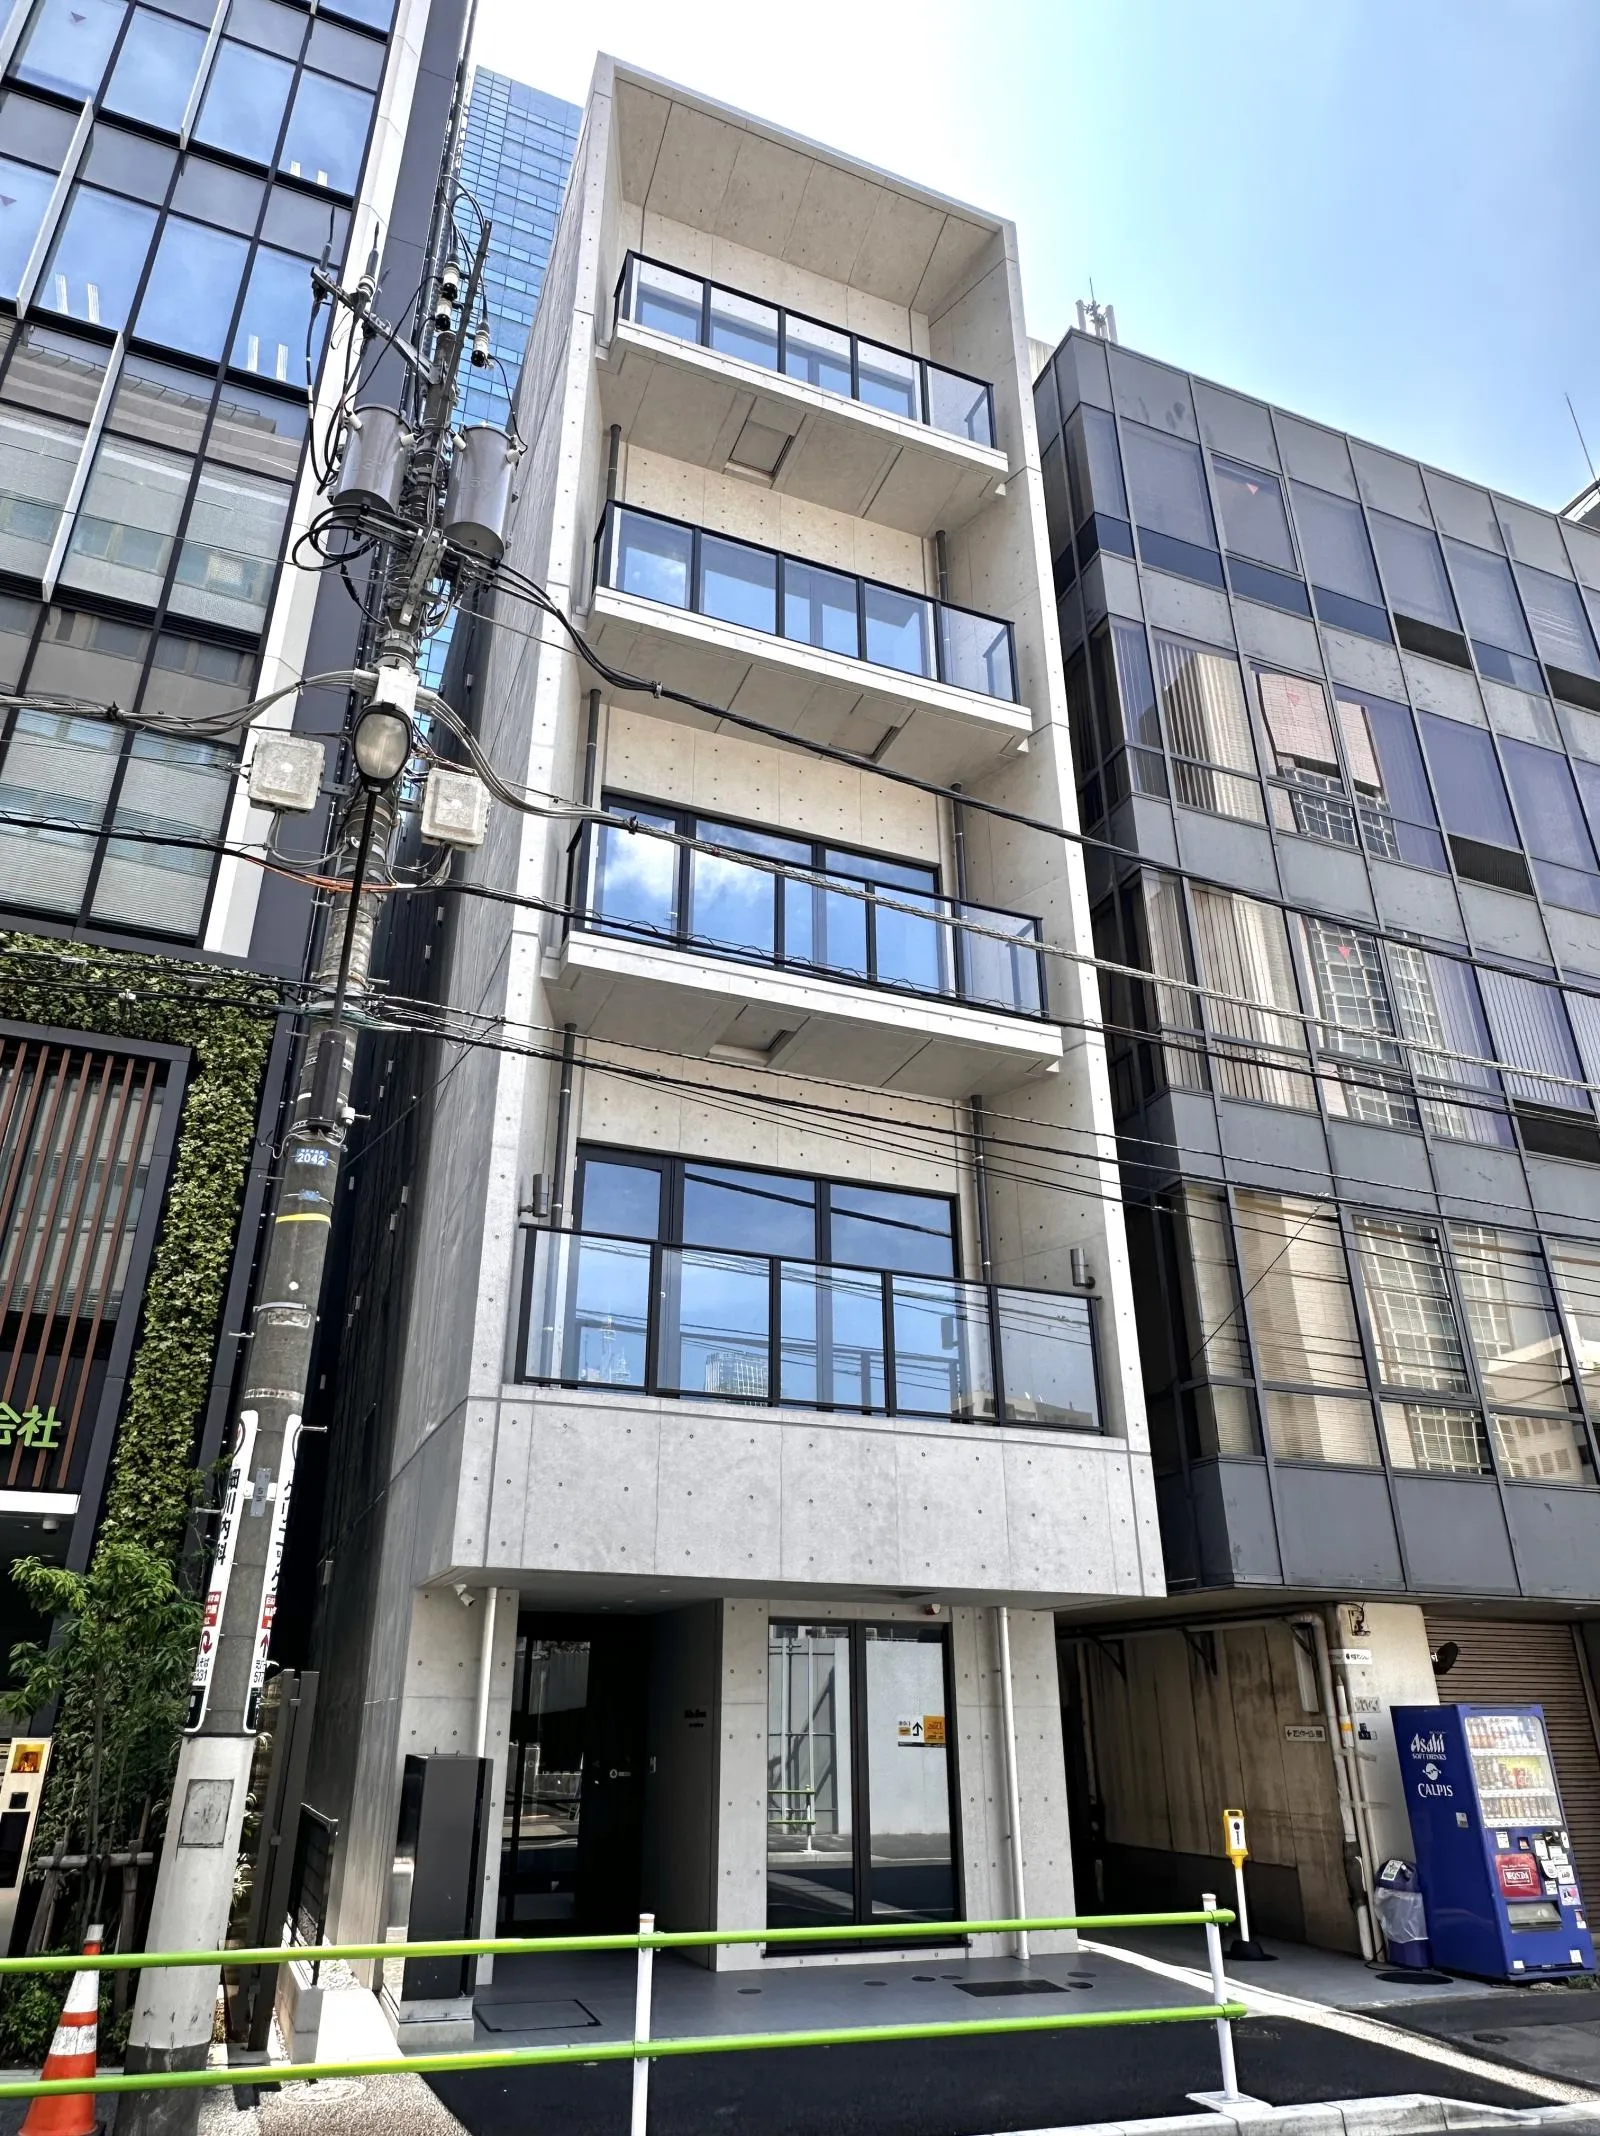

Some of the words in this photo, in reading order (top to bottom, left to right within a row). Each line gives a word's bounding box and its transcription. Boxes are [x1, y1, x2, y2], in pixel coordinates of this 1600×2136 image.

[295, 1152, 326, 1166] 2042
[1410, 1733, 1445, 1752] Asahi
[1418, 1783, 1453, 1798] CALPIS
